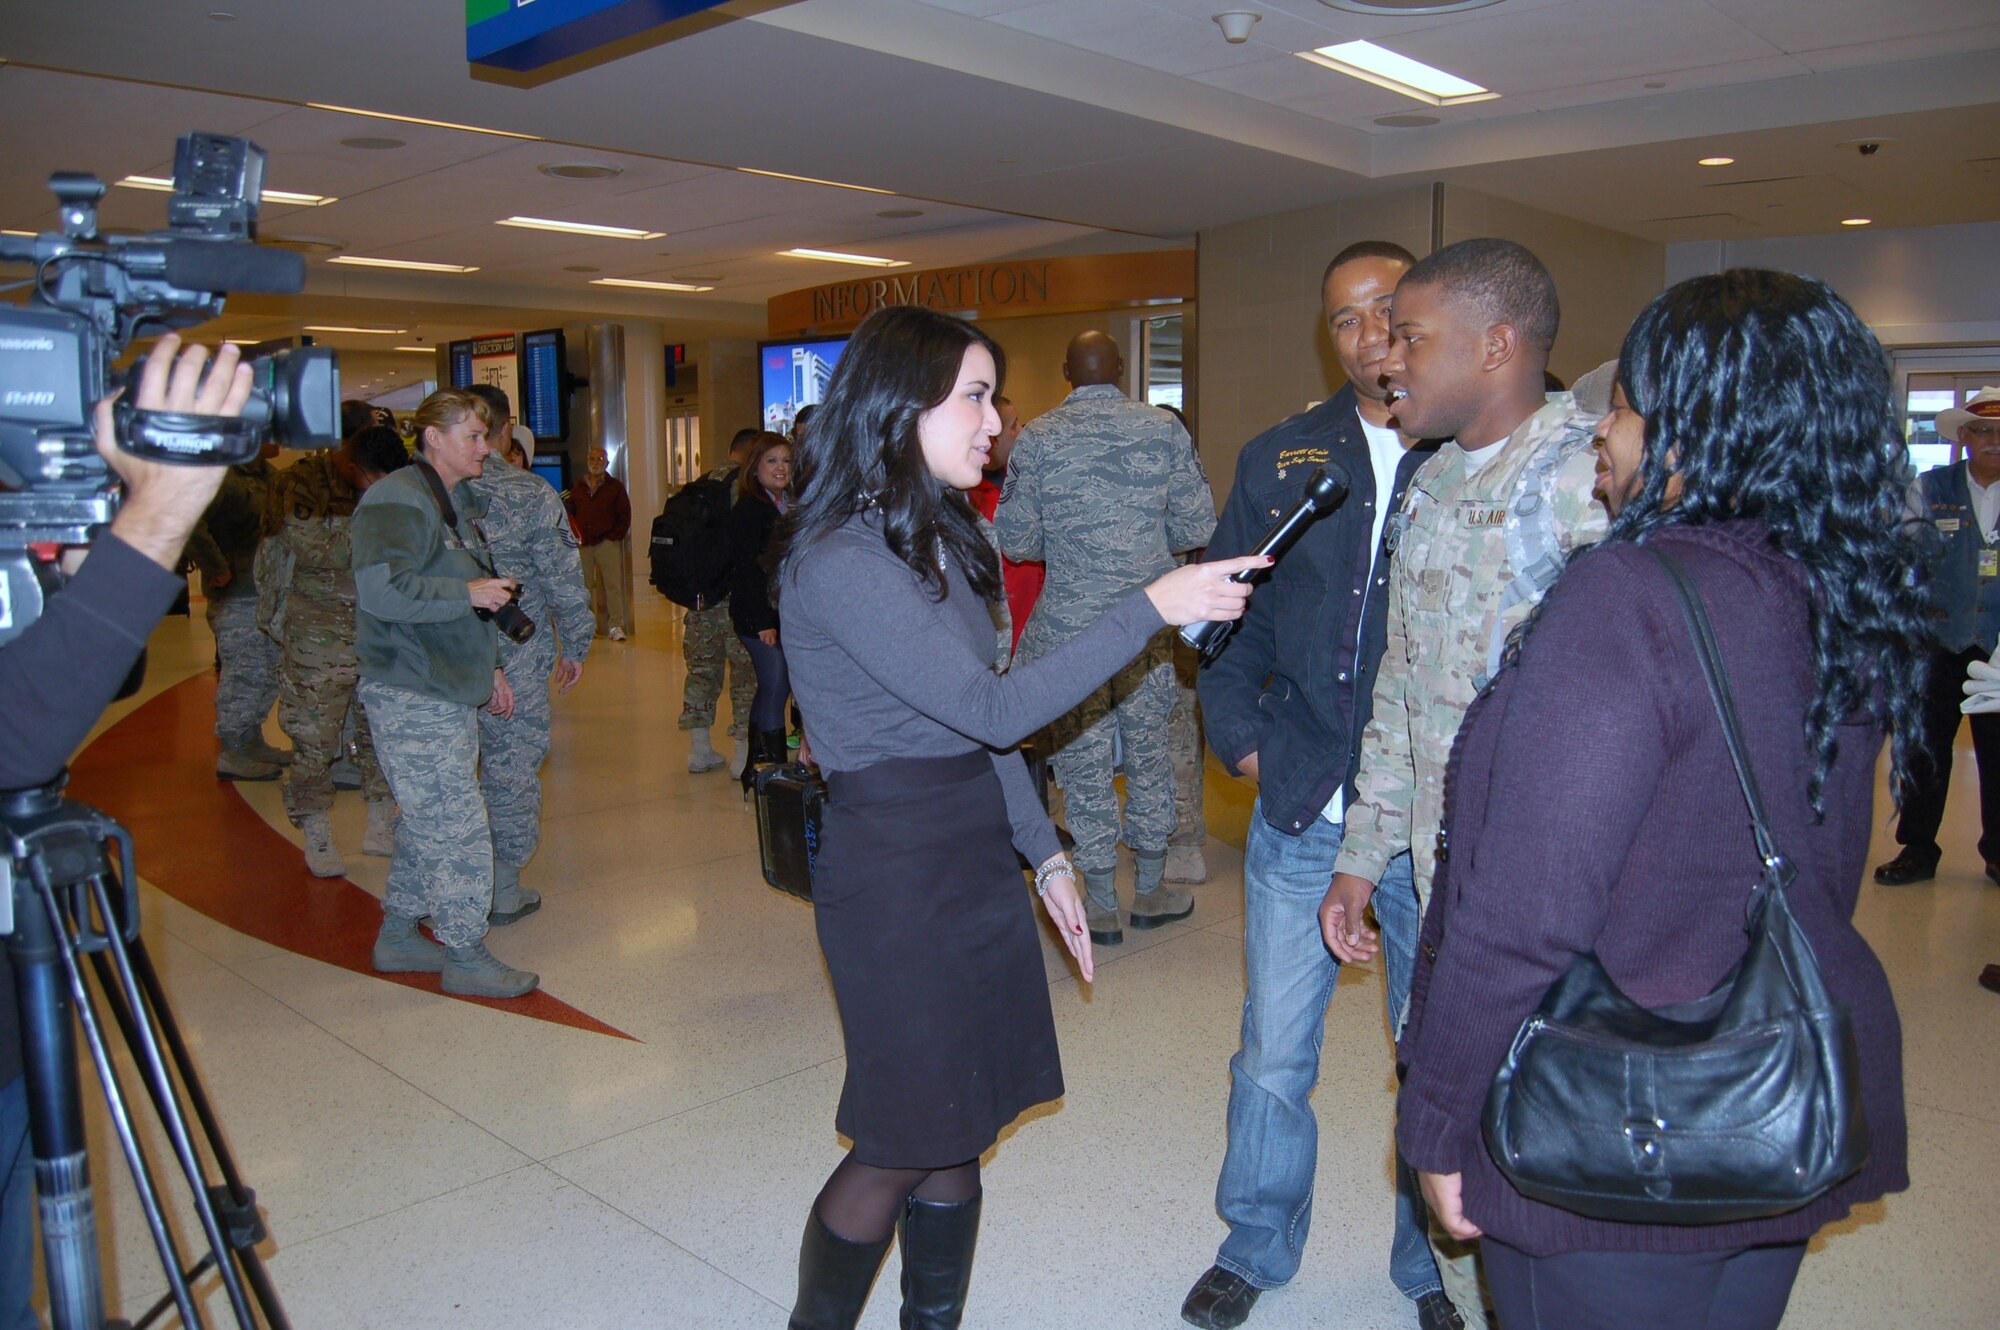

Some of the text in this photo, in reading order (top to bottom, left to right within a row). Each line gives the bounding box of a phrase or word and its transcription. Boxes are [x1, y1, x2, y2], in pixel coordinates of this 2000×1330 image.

[813, 265, 1049, 321] INFORMATION
[503, 342, 515, 352] MAP
[1486, 509, 1506, 525] AIR
